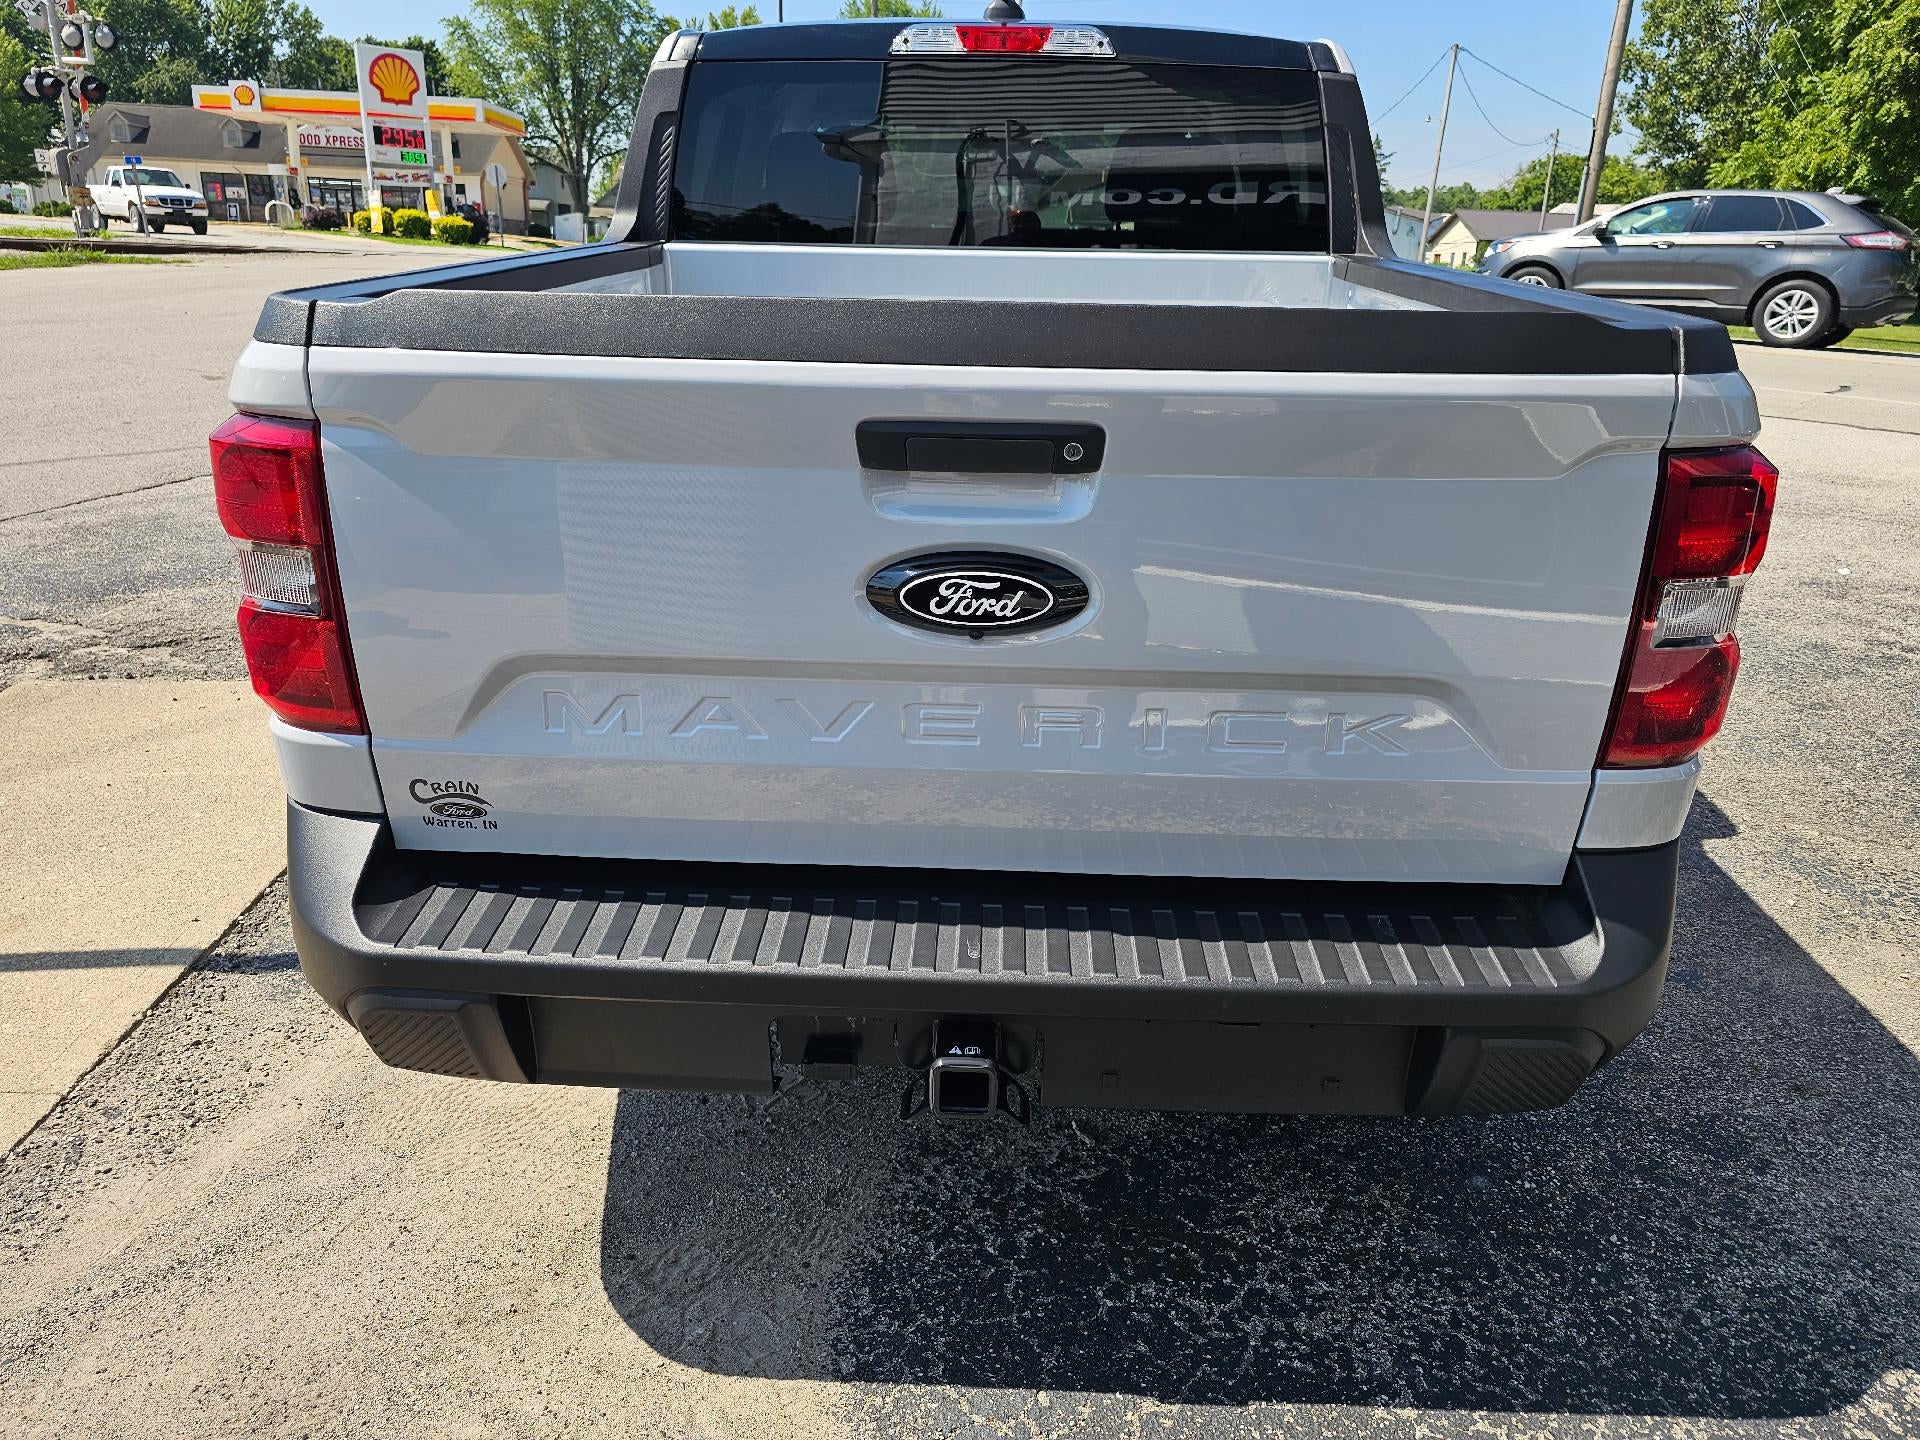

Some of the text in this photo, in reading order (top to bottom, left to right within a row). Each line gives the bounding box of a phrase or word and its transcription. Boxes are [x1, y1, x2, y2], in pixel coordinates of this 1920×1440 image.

[299, 133, 365, 148] OOD XPRESS
[929, 578, 1025, 618] Ford
[541, 688, 1412, 757] MAVERICK
[409, 778, 486, 804] CRAIN
[442, 804, 475, 817] Ford
[422, 816, 498, 830] Warren, IN
